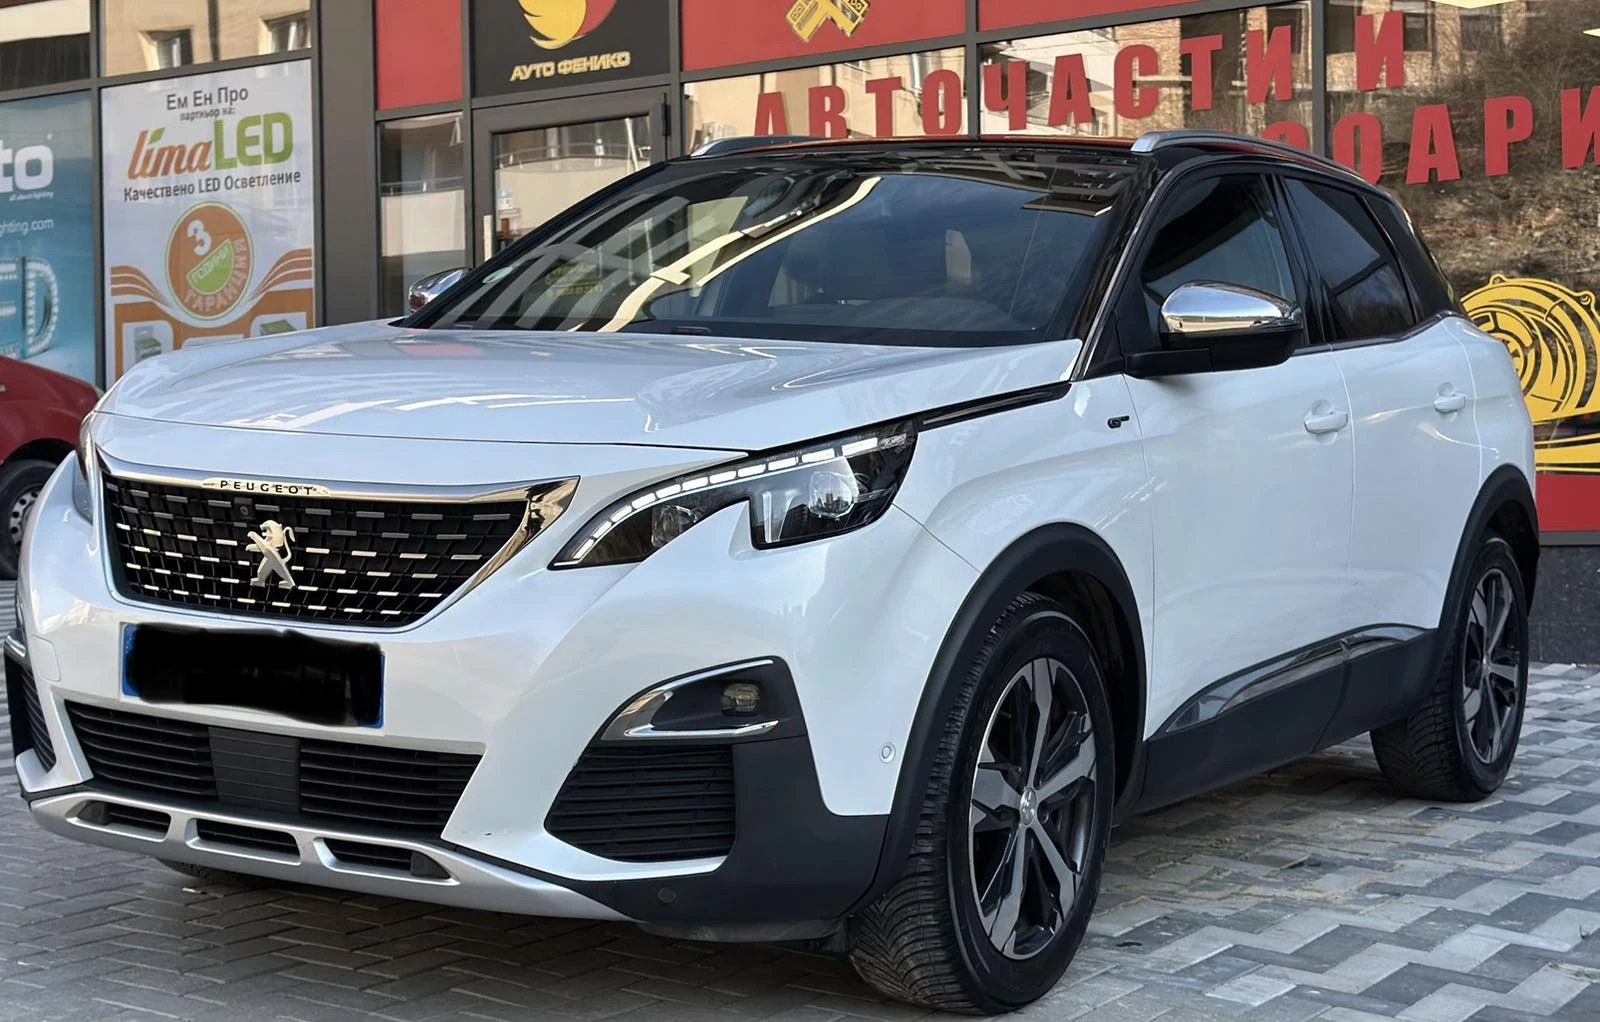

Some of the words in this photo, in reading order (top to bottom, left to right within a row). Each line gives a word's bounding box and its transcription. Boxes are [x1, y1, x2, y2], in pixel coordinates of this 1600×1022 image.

[510, 61, 555, 82] АУТО
[754, 25, 1292, 138] АВТОЧАСТИ
[1355, 11, 1405, 92] И
[167, 94, 188, 111] Ем
[193, 90, 213, 107] Ен
[218, 87, 248, 106] Про
[1261, 85, 1600, 185] ОАРИ
[124, 184, 195, 202] Качествено
[199, 178, 220, 194] LED
[224, 170, 301, 191] Осветление
[187, 219, 212, 256] 3
[220, 480, 314, 495] PEUGEOT
